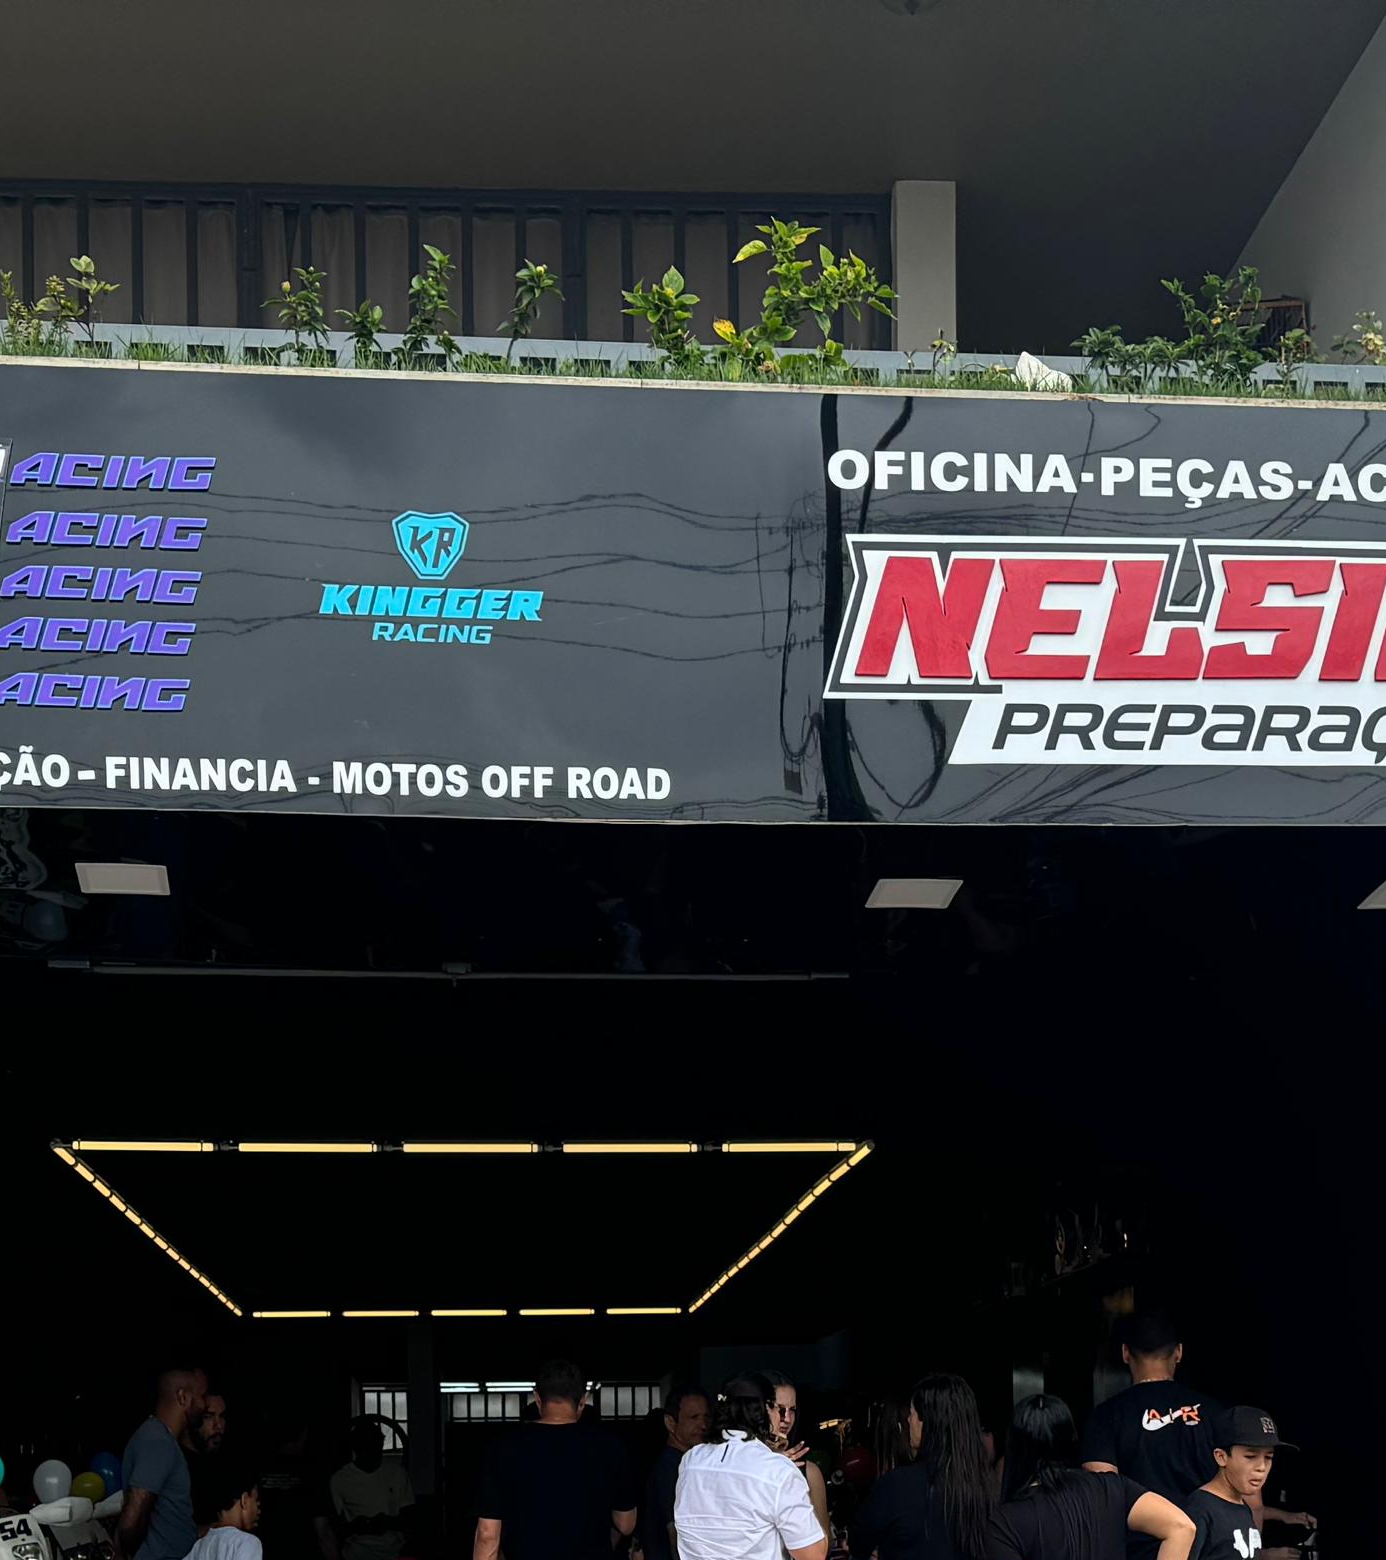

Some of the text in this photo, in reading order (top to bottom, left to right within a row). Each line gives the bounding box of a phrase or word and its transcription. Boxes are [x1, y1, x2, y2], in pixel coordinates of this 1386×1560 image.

[319, 583, 544, 622] KINGGER
[371, 622, 493, 645] RACING
[105, 756, 298, 793] FINANCIA
[332, 761, 469, 798] MOTOS
[481, 765, 554, 798] OFF
[567, 766, 672, 800] ROAD
